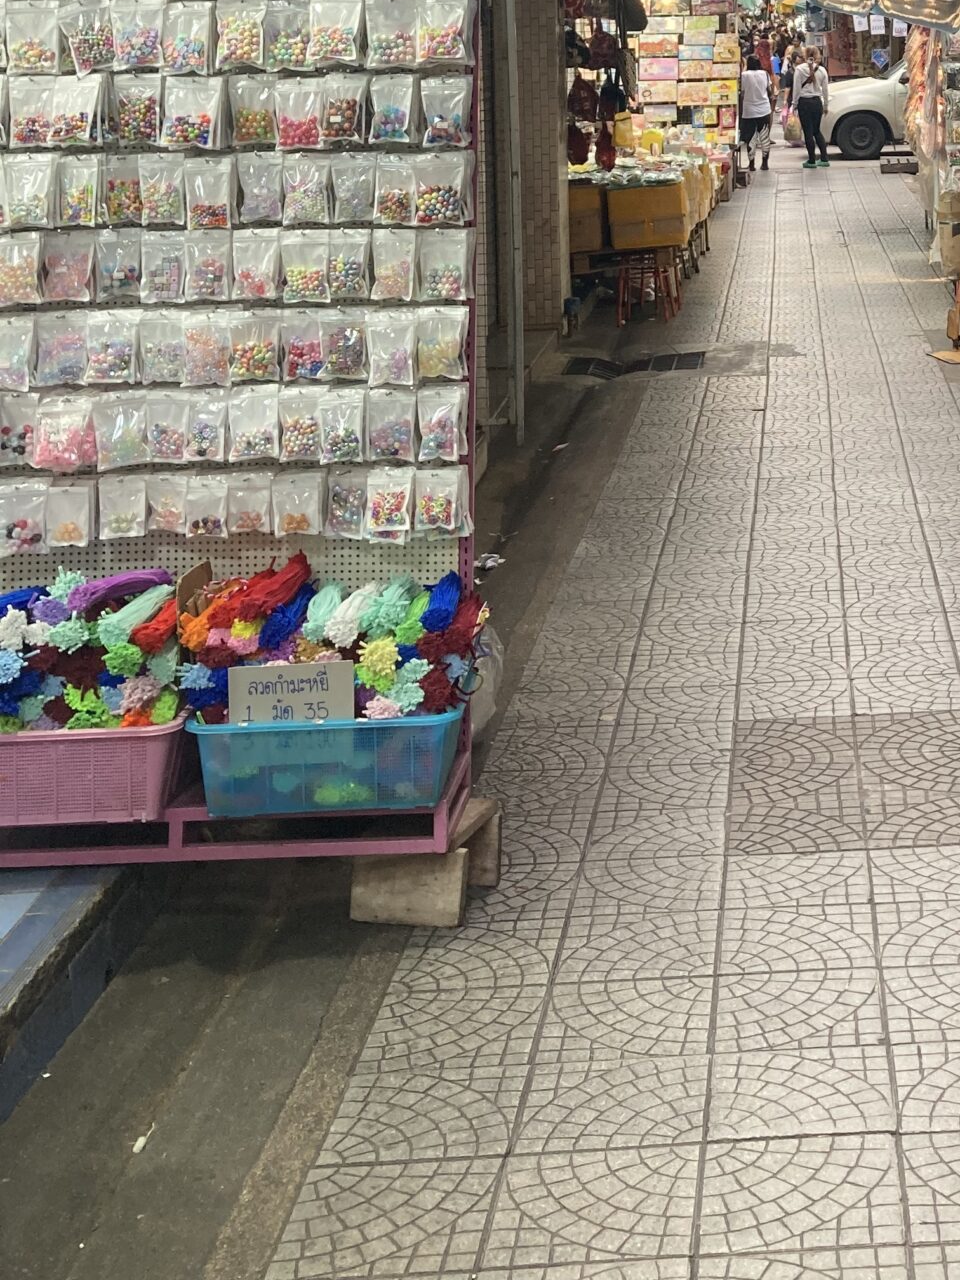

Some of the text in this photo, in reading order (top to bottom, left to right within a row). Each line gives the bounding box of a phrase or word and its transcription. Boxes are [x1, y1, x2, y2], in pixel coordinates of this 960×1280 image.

[247, 665, 329, 695] ลวดกำมะหยี่
[242, 699, 329, 722] 1 มัด 35
